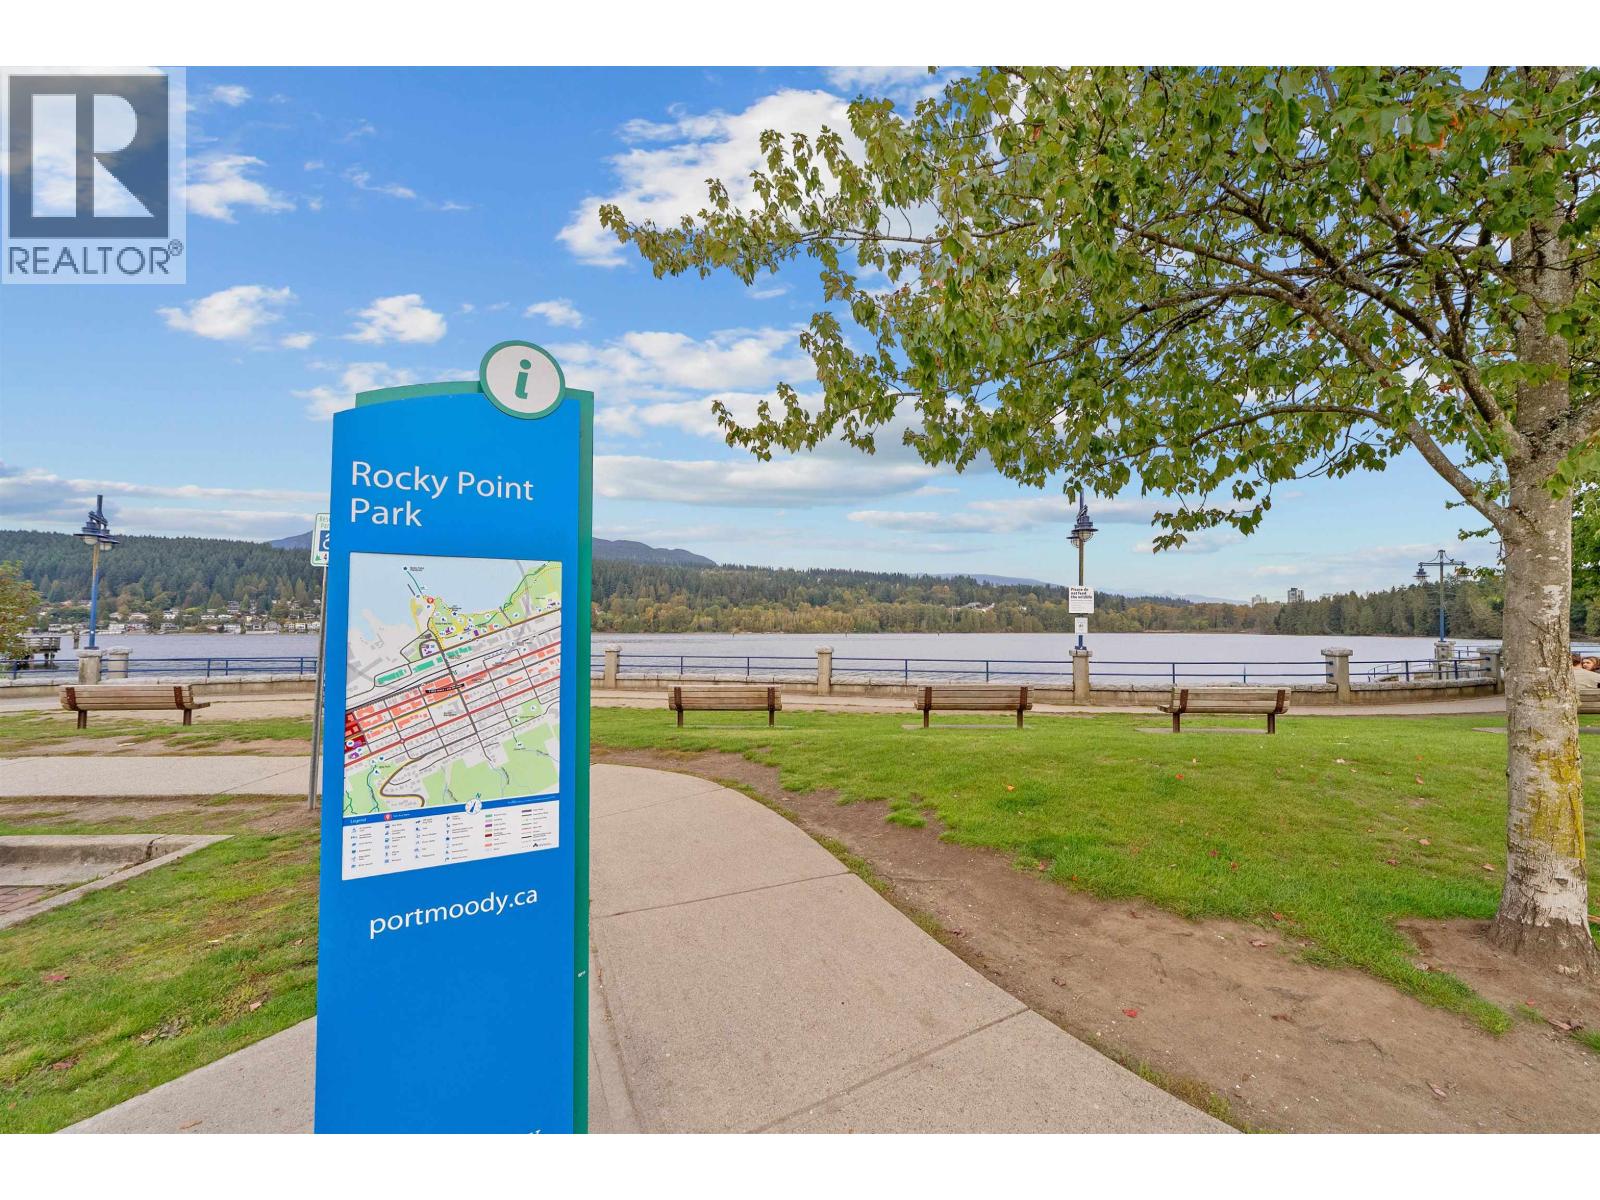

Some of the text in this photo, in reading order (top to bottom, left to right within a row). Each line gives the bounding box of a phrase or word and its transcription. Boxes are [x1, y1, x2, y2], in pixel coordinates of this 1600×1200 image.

[351, 460, 534, 501] Rocky Point
[350, 497, 423, 527] Park
[369, 889, 538, 939] portmoody.ca
